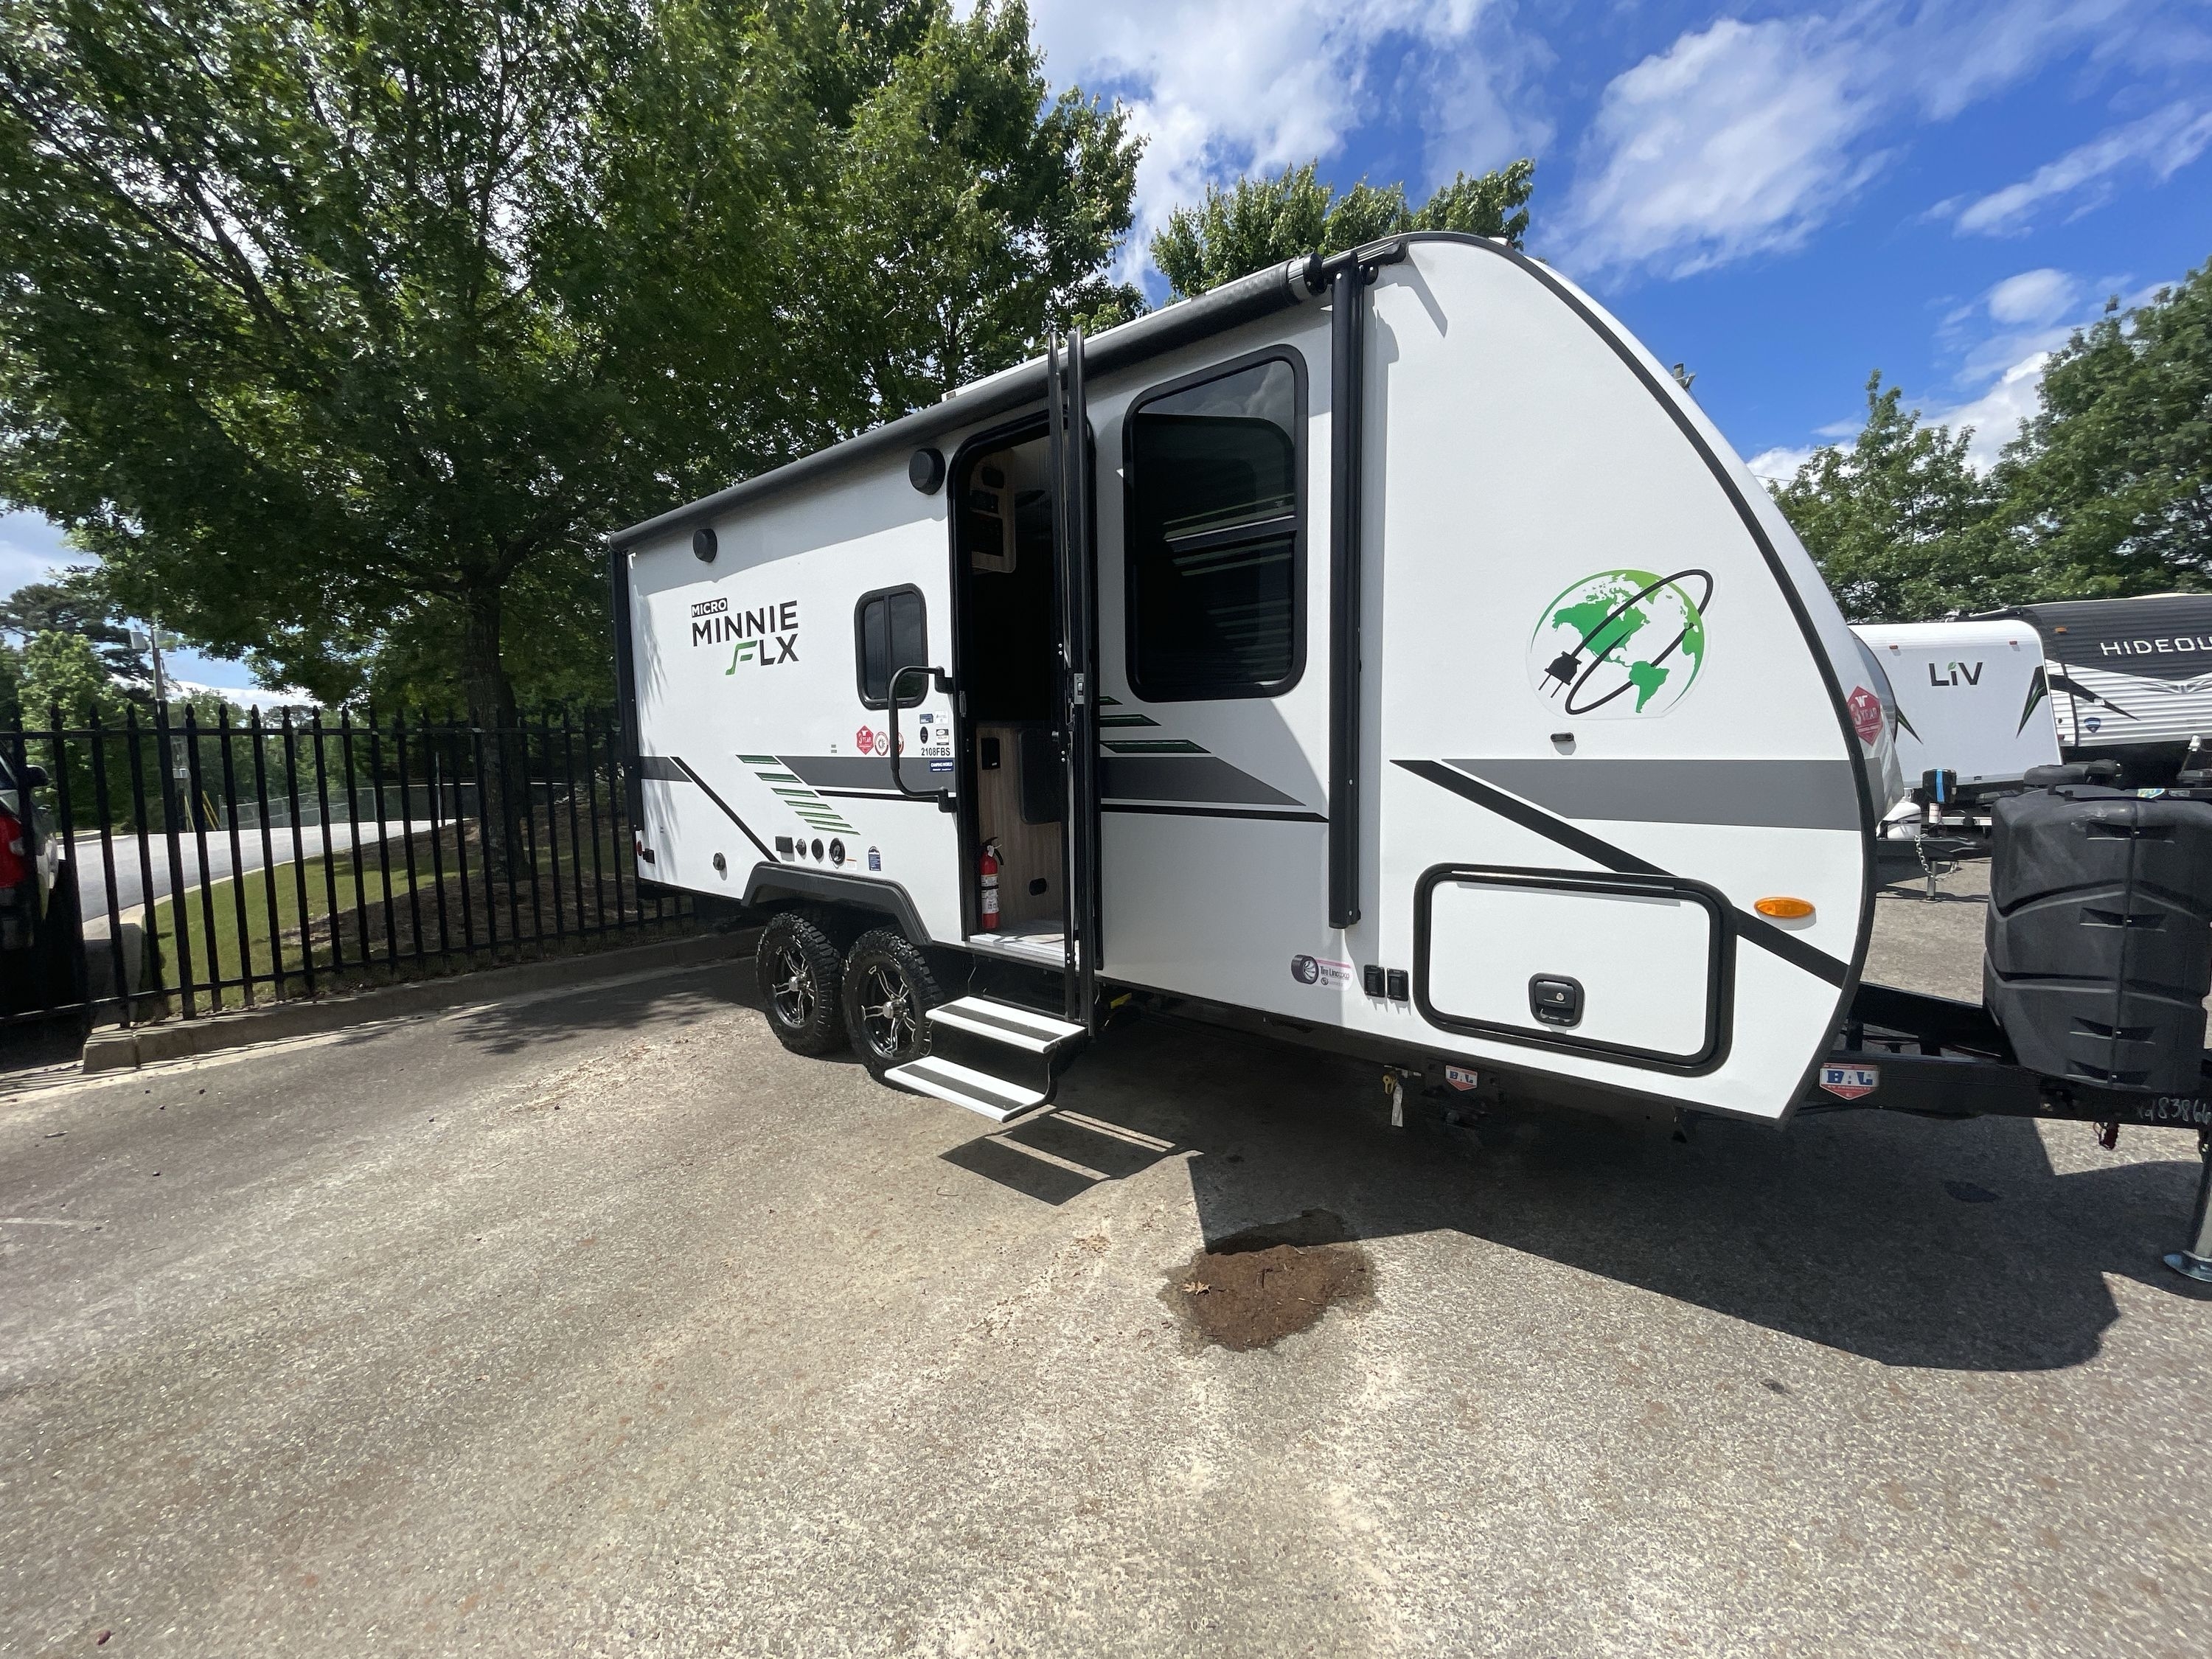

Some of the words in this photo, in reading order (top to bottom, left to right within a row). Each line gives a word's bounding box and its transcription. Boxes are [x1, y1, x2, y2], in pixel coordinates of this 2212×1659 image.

[692, 599, 727, 617] MICRO
[692, 599, 799, 647] MINNIE
[725, 633, 800, 676] FLX
[1860, 707, 1878, 721] YEAR
[921, 747, 950, 757] 2108FBS
